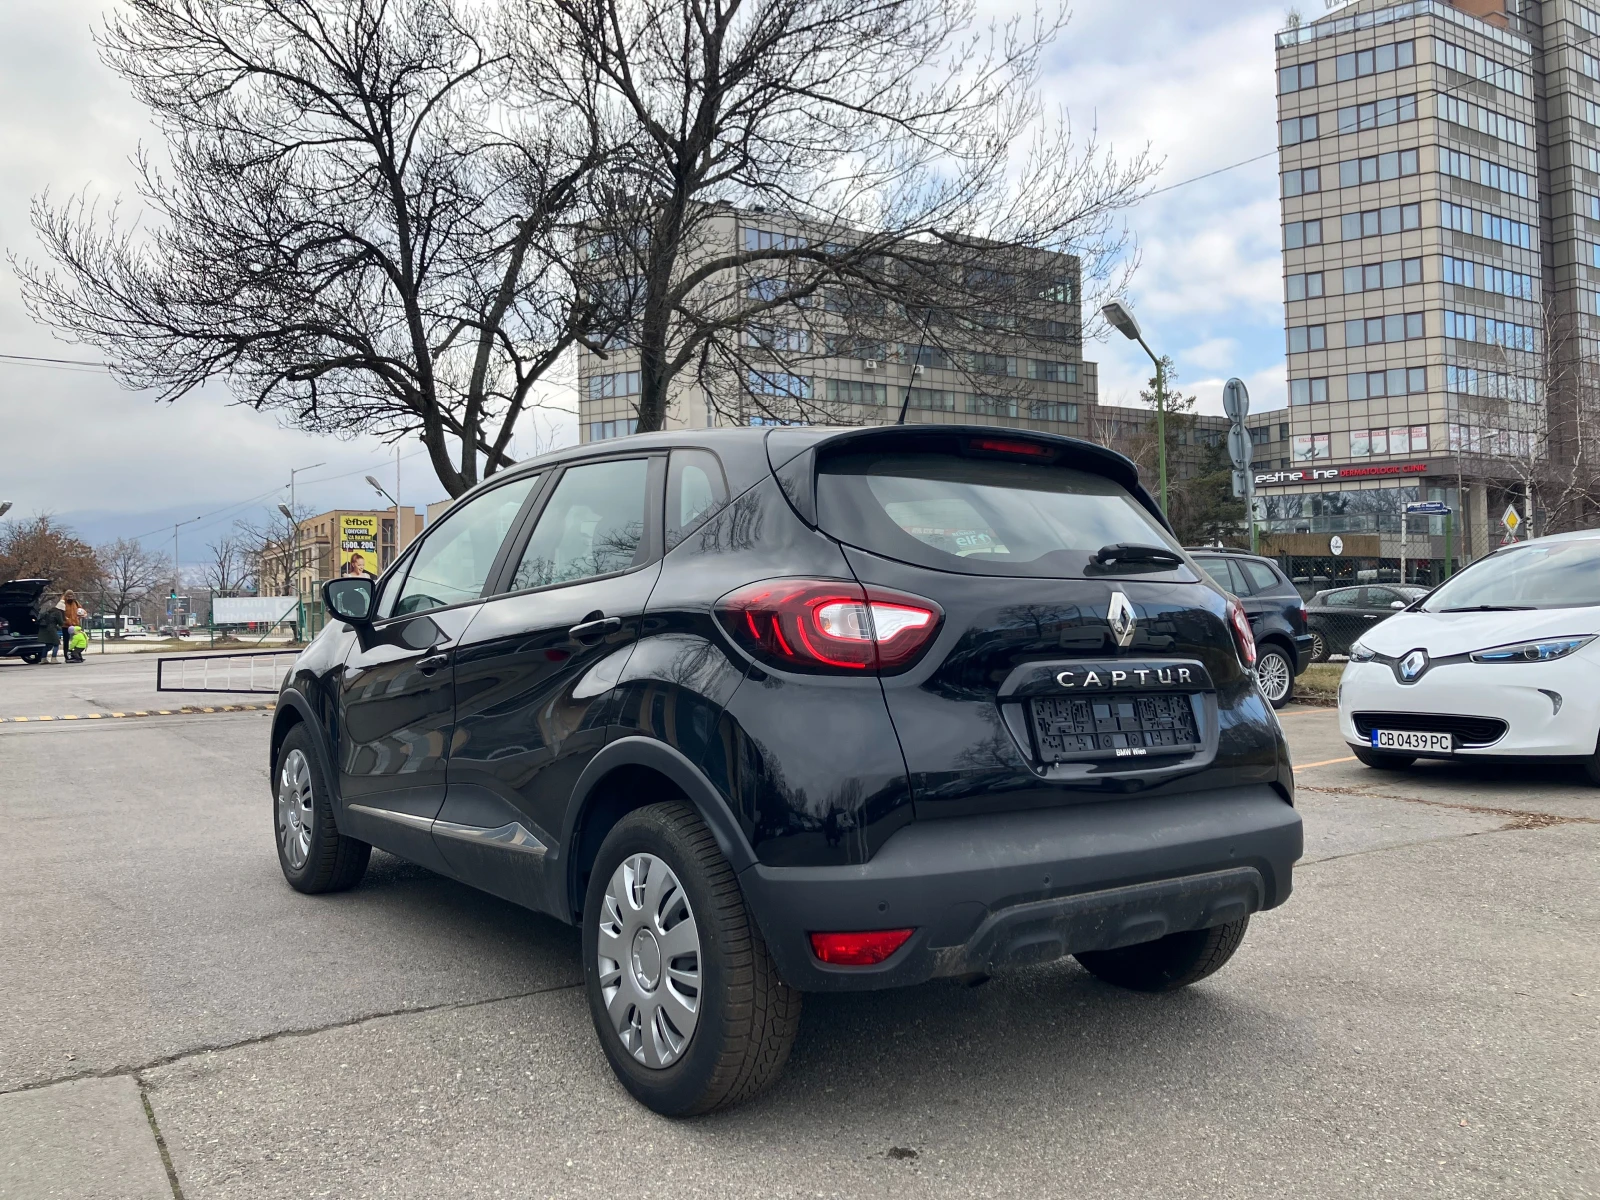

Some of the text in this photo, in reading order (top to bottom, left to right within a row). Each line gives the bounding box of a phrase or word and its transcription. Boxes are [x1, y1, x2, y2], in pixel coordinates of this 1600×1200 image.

[1254, 464, 1428, 484] estheLine DERMATOLOGIC CLINIC
[344, 518, 374, 526] efbet
[956, 535, 977, 546] elf
[1056, 668, 1192, 688] CAPTUR
